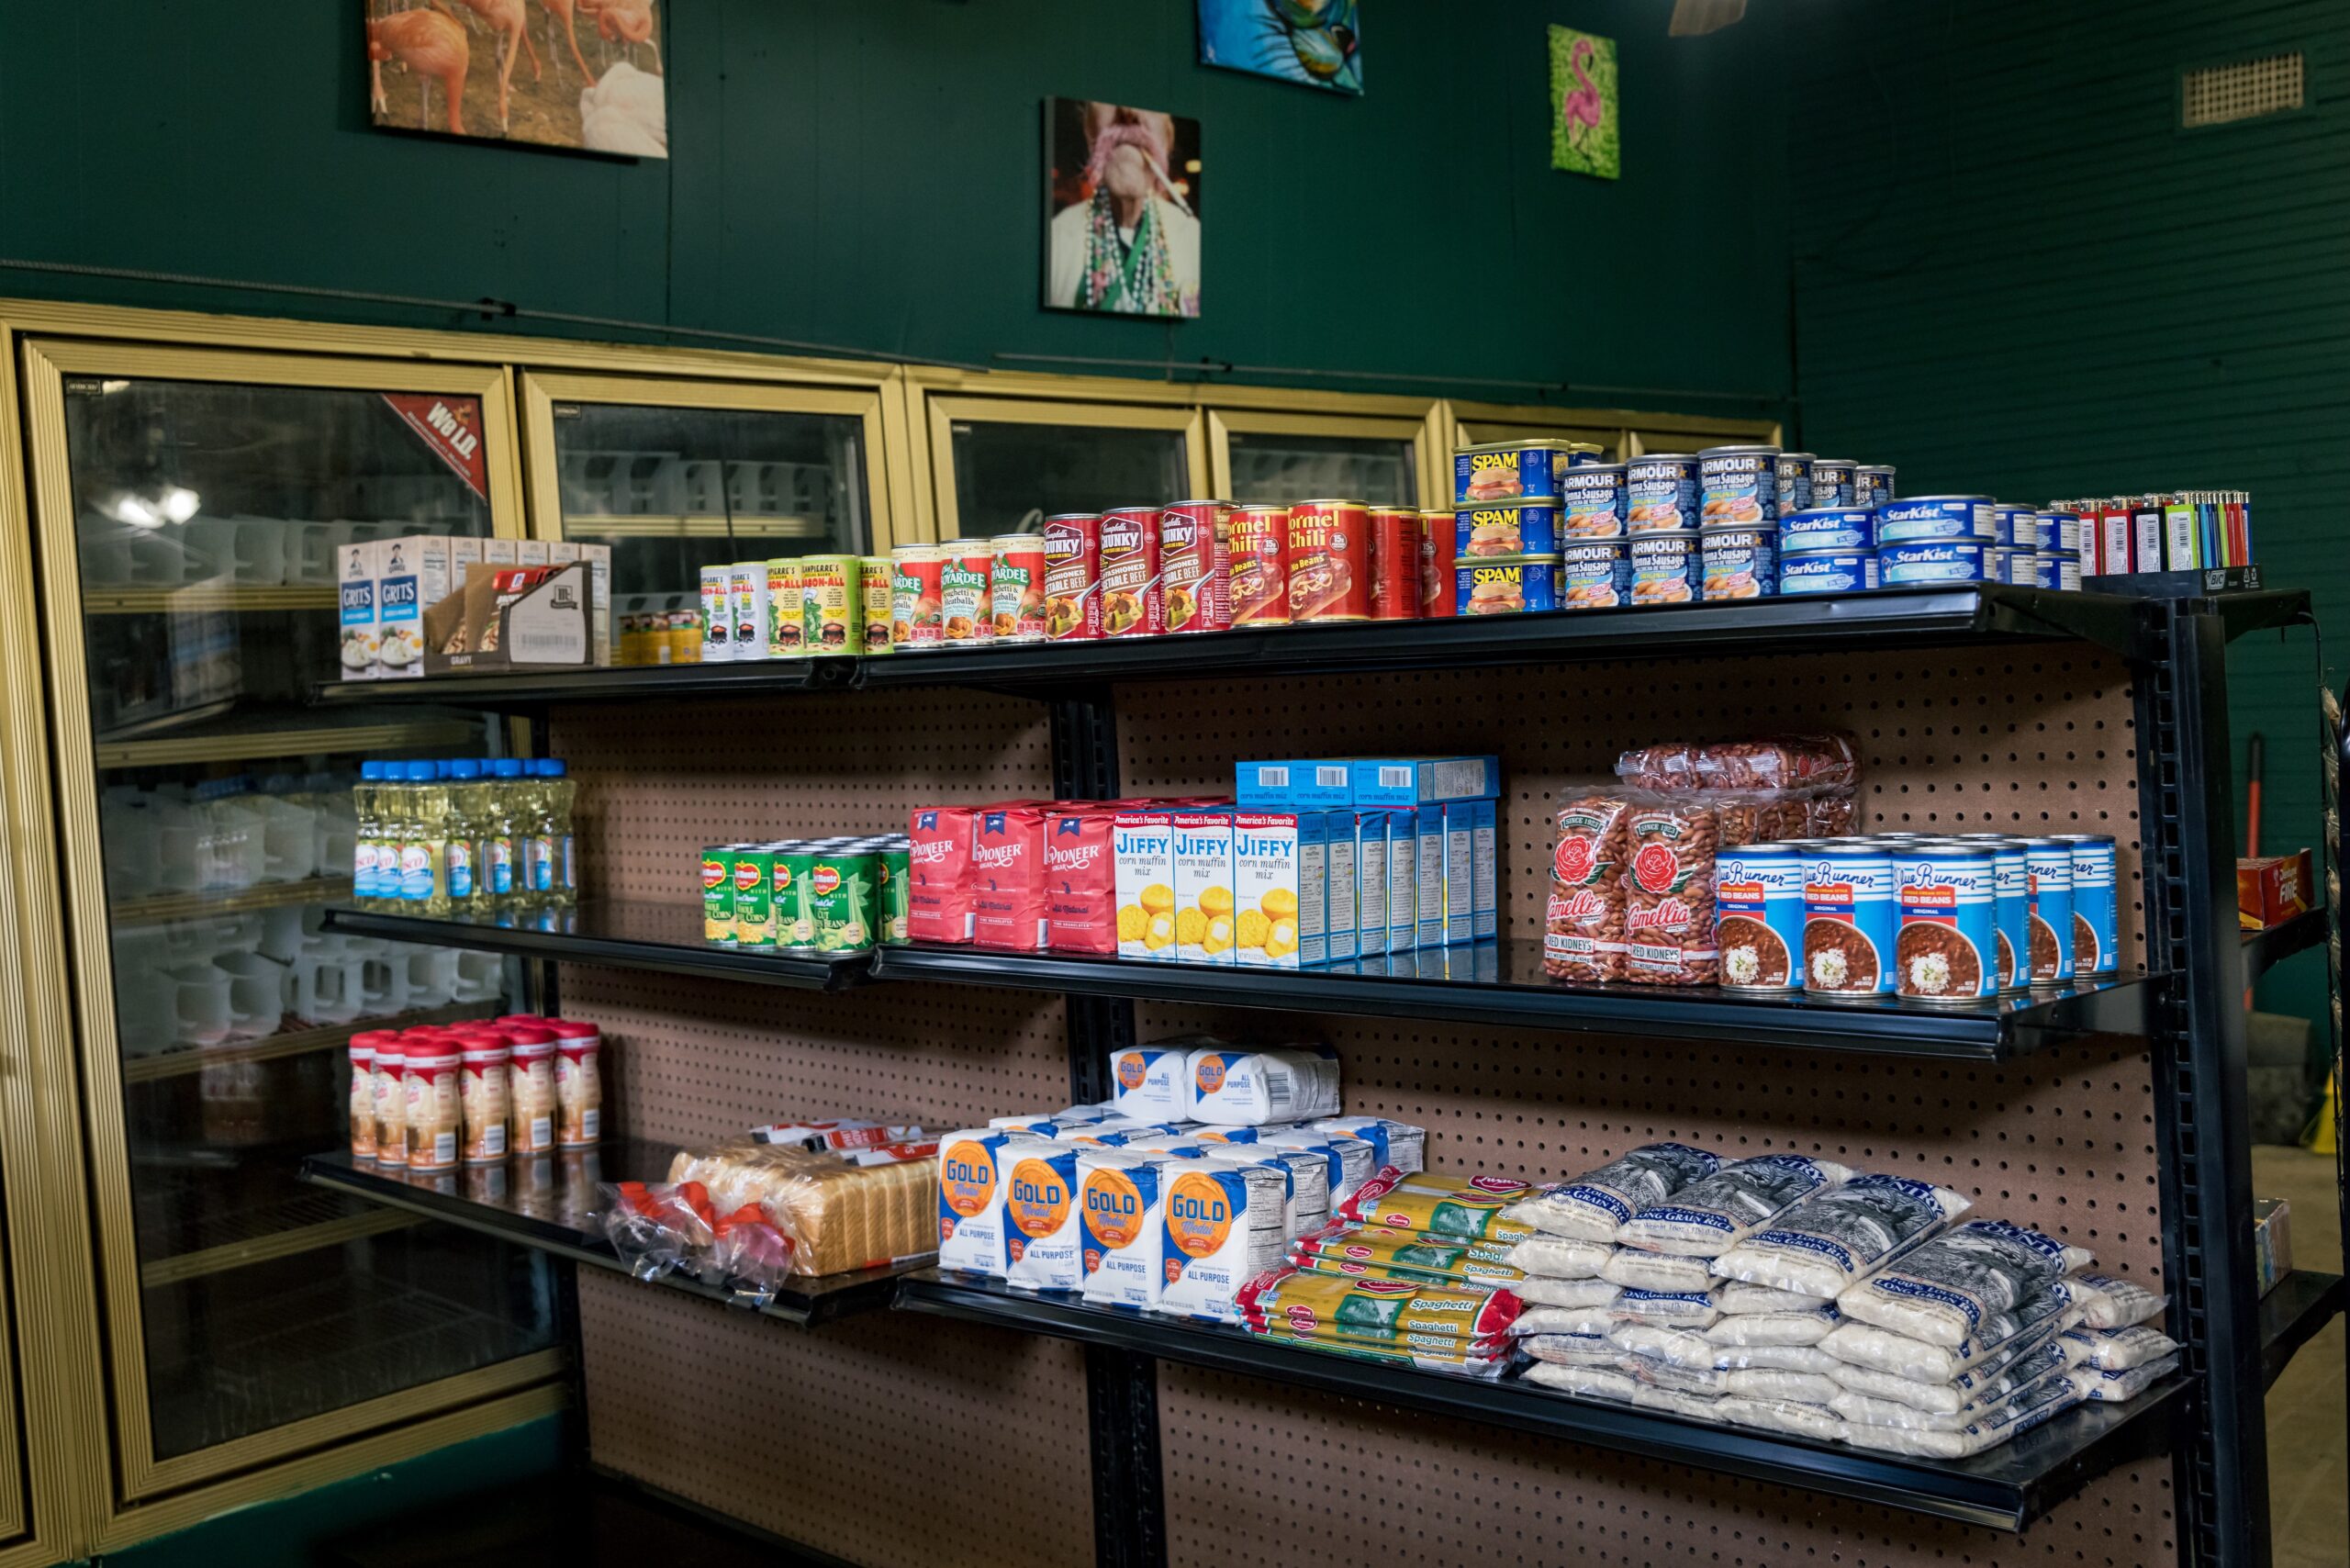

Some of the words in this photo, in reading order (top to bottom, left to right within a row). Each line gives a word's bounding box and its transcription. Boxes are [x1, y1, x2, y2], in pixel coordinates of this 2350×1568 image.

[1472, 453, 1518, 471] SPAM
[1702, 459, 1755, 473] ARMOUR
[1564, 475, 1614, 489] ARMOUR
[1643, 480, 1675, 494] Sausage
[1721, 473, 1755, 487] Sausage
[1582, 488, 1614, 502] Sausage
[1472, 510, 1518, 527] SPAM
[1887, 506, 1940, 521] StarKist
[1790, 517, 1841, 532] StarKist
[1290, 530, 1326, 548] Chili
[1046, 539, 1080, 554] HUNKY
[1631, 541, 1685, 554] ARMOUR
[1299, 555, 1325, 567] Beans
[1652, 554, 1685, 568] Sausage
[1718, 549, 1751, 563] Sausage
[1897, 547, 1953, 563] StarKist
[1183, 566, 1201, 577] BEEF
[1235, 560, 1257, 573] Beans
[1580, 561, 1610, 575] Sausage
[1785, 561, 1831, 576] StarKist
[943, 573, 985, 588] OYARDEE
[1070, 577, 1086, 588] BEEF
[1130, 571, 1146, 583] BEEF
[1473, 566, 1521, 585] SPAM
[343, 587, 371, 606] GRITS
[383, 582, 414, 603] GRITS
[451, 655, 472, 665] GRAVY
[1114, 815, 1143, 824] America's
[1145, 816, 1169, 824] Favorite
[1174, 816, 1203, 824] America's
[1204, 817, 1228, 825] Favorite
[1236, 816, 1266, 826] America's
[1267, 817, 1293, 826] Favorite
[1584, 819, 1599, 827] 1923
[1661, 825, 1675, 834] 1923
[911, 840, 954, 857] PIONEER
[1116, 834, 1169, 854] JIFFY
[1176, 834, 1228, 856] JIFFY
[1237, 834, 1292, 857] JIFFY
[978, 844, 1022, 861] PIONEER
[1048, 846, 1100, 863] PIONEER
[1138, 857, 1166, 866] muffin
[1179, 858, 1195, 867] corn
[1198, 857, 1225, 868] muffin
[1239, 859, 1258, 868] corn
[1259, 858, 1291, 869] muffin
[1135, 868, 1151, 876] mix
[1194, 868, 1210, 878] mix
[1255, 870, 1273, 880] mix
[1730, 861, 1785, 886] Runner
[1817, 861, 1874, 888] Runner
[1917, 863, 1976, 890] Runner
[1733, 892, 1760, 901] BEANS
[1820, 893, 1848, 902] BEANS
[2279, 879, 2298, 904] FIRE
[1904, 896, 1919, 904] RED
[1920, 896, 1952, 904] BEANS
[1628, 899, 1689, 935] Camellia
[1549, 935, 1559, 946] RED
[1633, 946, 1645, 958] RED
[1121, 1061, 1143, 1073] GOLD
[1199, 1065, 1223, 1076] GOLD
[1227, 1081, 1251, 1089] PURPOSE
[947, 1159, 989, 1184] GOLD
[954, 1183, 979, 1196] Medal
[1013, 1179, 1061, 1205] GOLD
[1087, 1188, 1136, 1215] GOLD
[1573, 1191, 1608, 1207] GRAIN
[1585, 1187, 1629, 1218] LOUISIANA
[1021, 1204, 1051, 1218] Medal
[1172, 1194, 1225, 1222] GOLD
[1097, 1214, 1127, 1228] Medal
[1666, 1212, 1702, 1224] GRAIN
[1704, 1218, 1733, 1232] RICE
[1674, 1208, 1728, 1223] LOUISIANA
[959, 1228, 968, 1238] ALL
[969, 1229, 995, 1240] PURPOSE
[1181, 1221, 1214, 1236] Medal
[1030, 1249, 1040, 1259] ALL
[1042, 1250, 1074, 1260] PURPOSE
[1785, 1238, 1823, 1251] GRAIN
[1825, 1247, 1854, 1272] RICE
[1106, 1260, 1116, 1271] ALL
[1118, 1262, 1147, 1273] PURPOSE
[1464, 1264, 1513, 1276] Spaghetti
[1188, 1271, 1198, 1280] ALL
[1200, 1271, 1230, 1284] PURPOSE
[1875, 1280, 1912, 1294] LONG
[1914, 1288, 1956, 1305] GRAIN
[1412, 1299, 1475, 1312] Spaghetti
[1409, 1320, 1458, 1334] Spaghetti
[1408, 1334, 1455, 1348] Spaghetti
